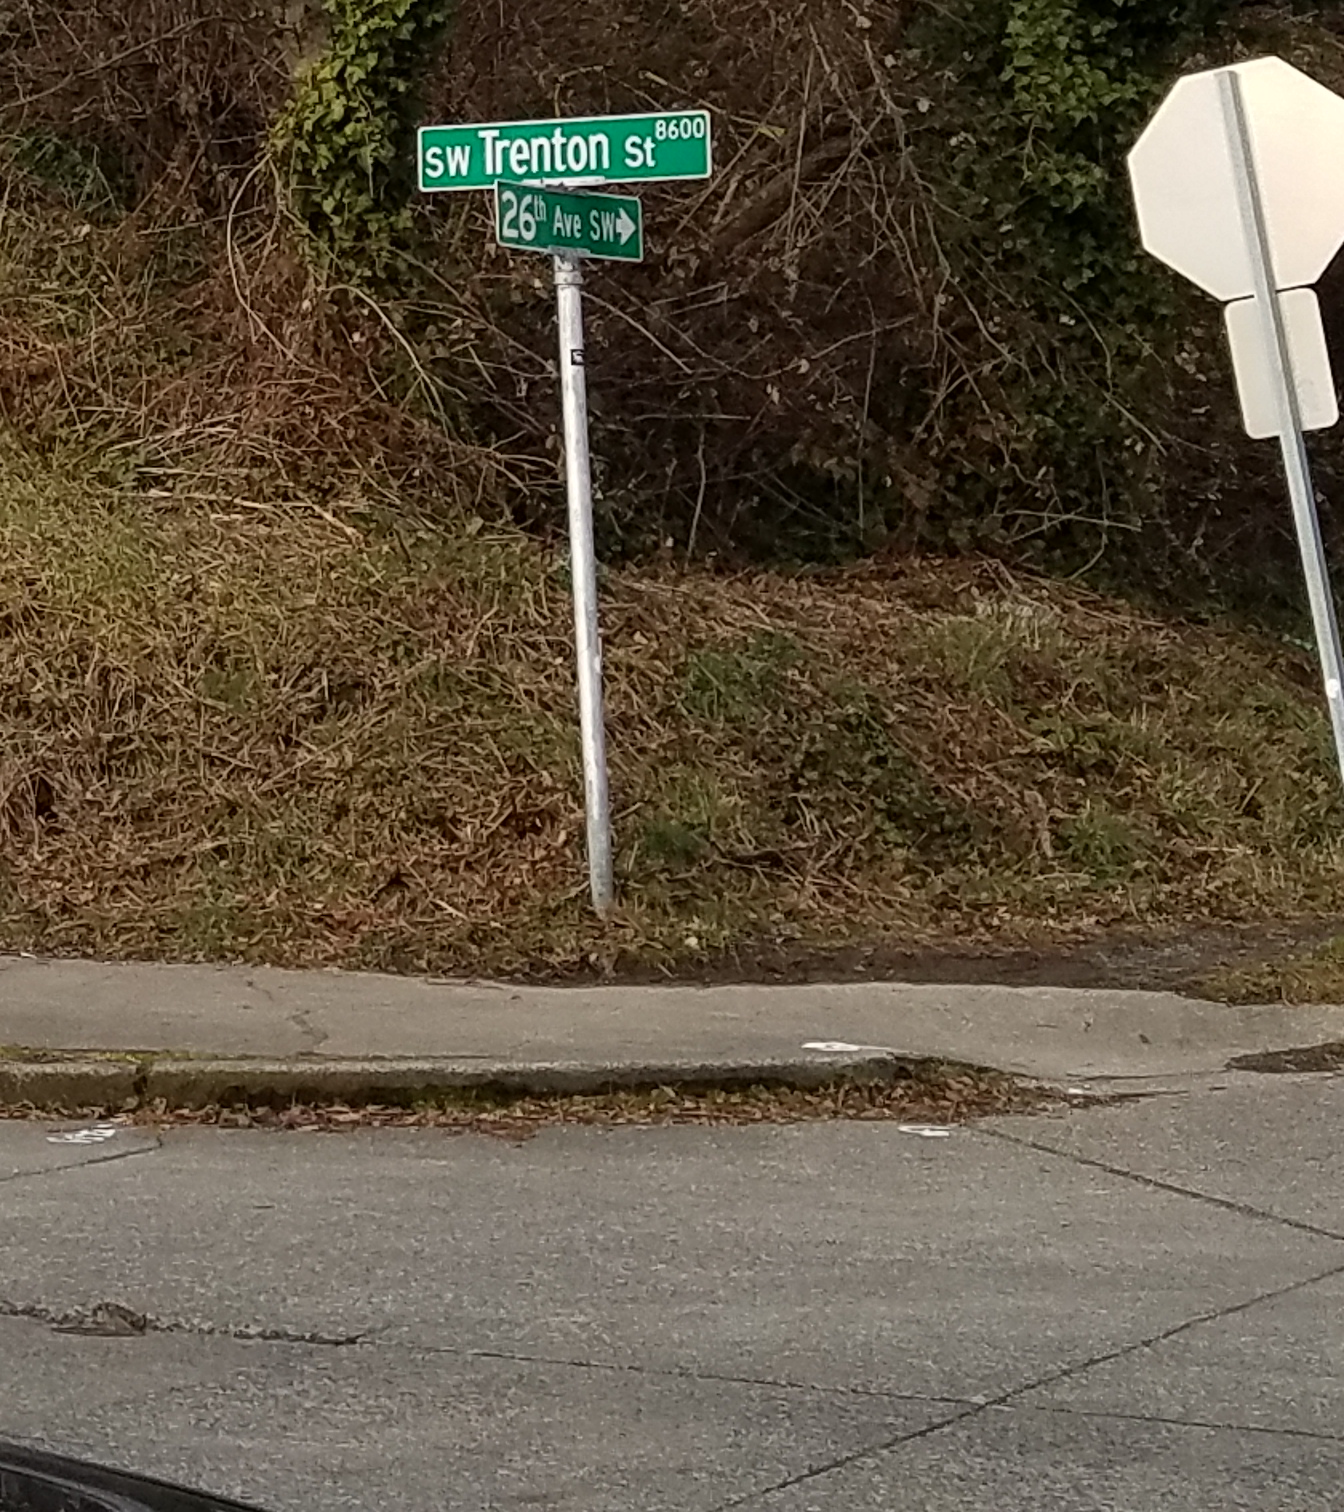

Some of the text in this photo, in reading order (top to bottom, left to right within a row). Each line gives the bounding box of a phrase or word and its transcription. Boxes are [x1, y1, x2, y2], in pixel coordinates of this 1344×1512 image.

[425, 127, 656, 178] SW Trenton St
[655, 117, 705, 139] 8600
[501, 191, 615, 243] 26th Ave SW
